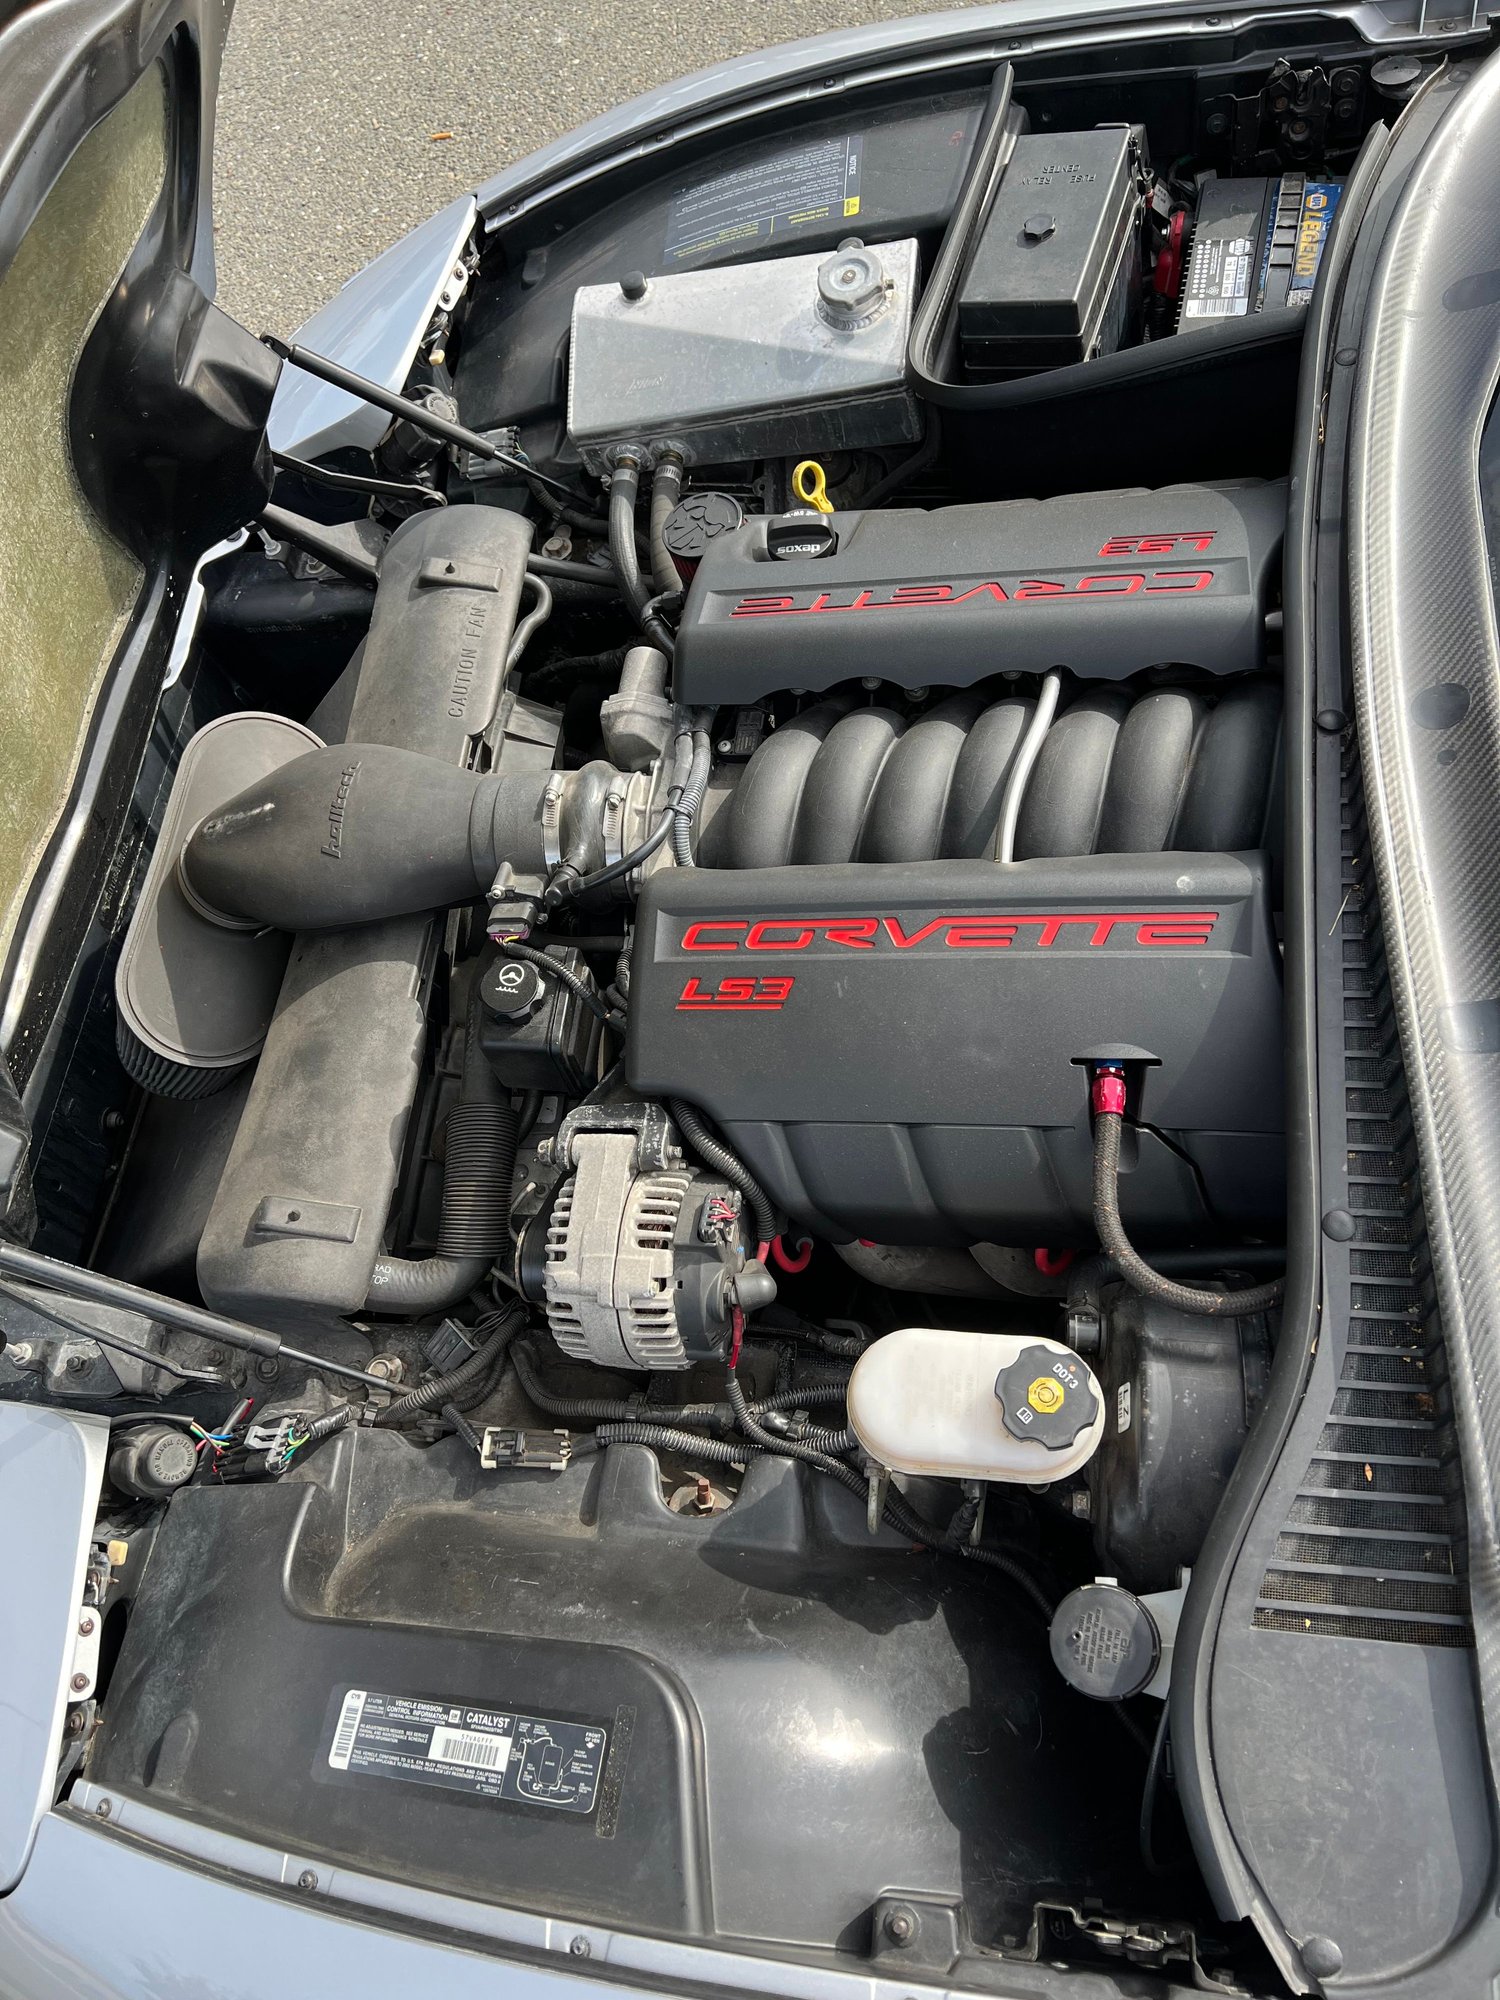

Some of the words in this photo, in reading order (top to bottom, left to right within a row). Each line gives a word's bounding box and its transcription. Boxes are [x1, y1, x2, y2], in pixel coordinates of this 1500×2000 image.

[848, 154, 857, 176] NOTICE
[1042, 164, 1081, 174] CENTER
[1020, 176, 1052, 185] RELAY
[1070, 174, 1097, 184] FUSE
[1296, 211, 1324, 277] LEGEND
[777, 543, 821, 555] dexos
[1098, 533, 1216, 557] LS3
[729, 569, 1215, 617] CORVETTE
[448, 648, 478, 717] CAUTION
[466, 607, 488, 638] FAN
[321, 761, 362, 859] halltech
[680, 912, 1219, 950] CORVETTE
[678, 976, 796, 1002] LS3
[154, 1439, 174, 1461] MANUAL
[176, 1438, 194, 1467] OPERATION
[386, 1705, 411, 1714] CONTROL
[412, 1709, 448, 1720] INFORMATION
[395, 1699, 416, 1708] VEHICLE
[417, 1703, 443, 1712] EMISSION
[465, 1711, 510, 1728] CATALYST
